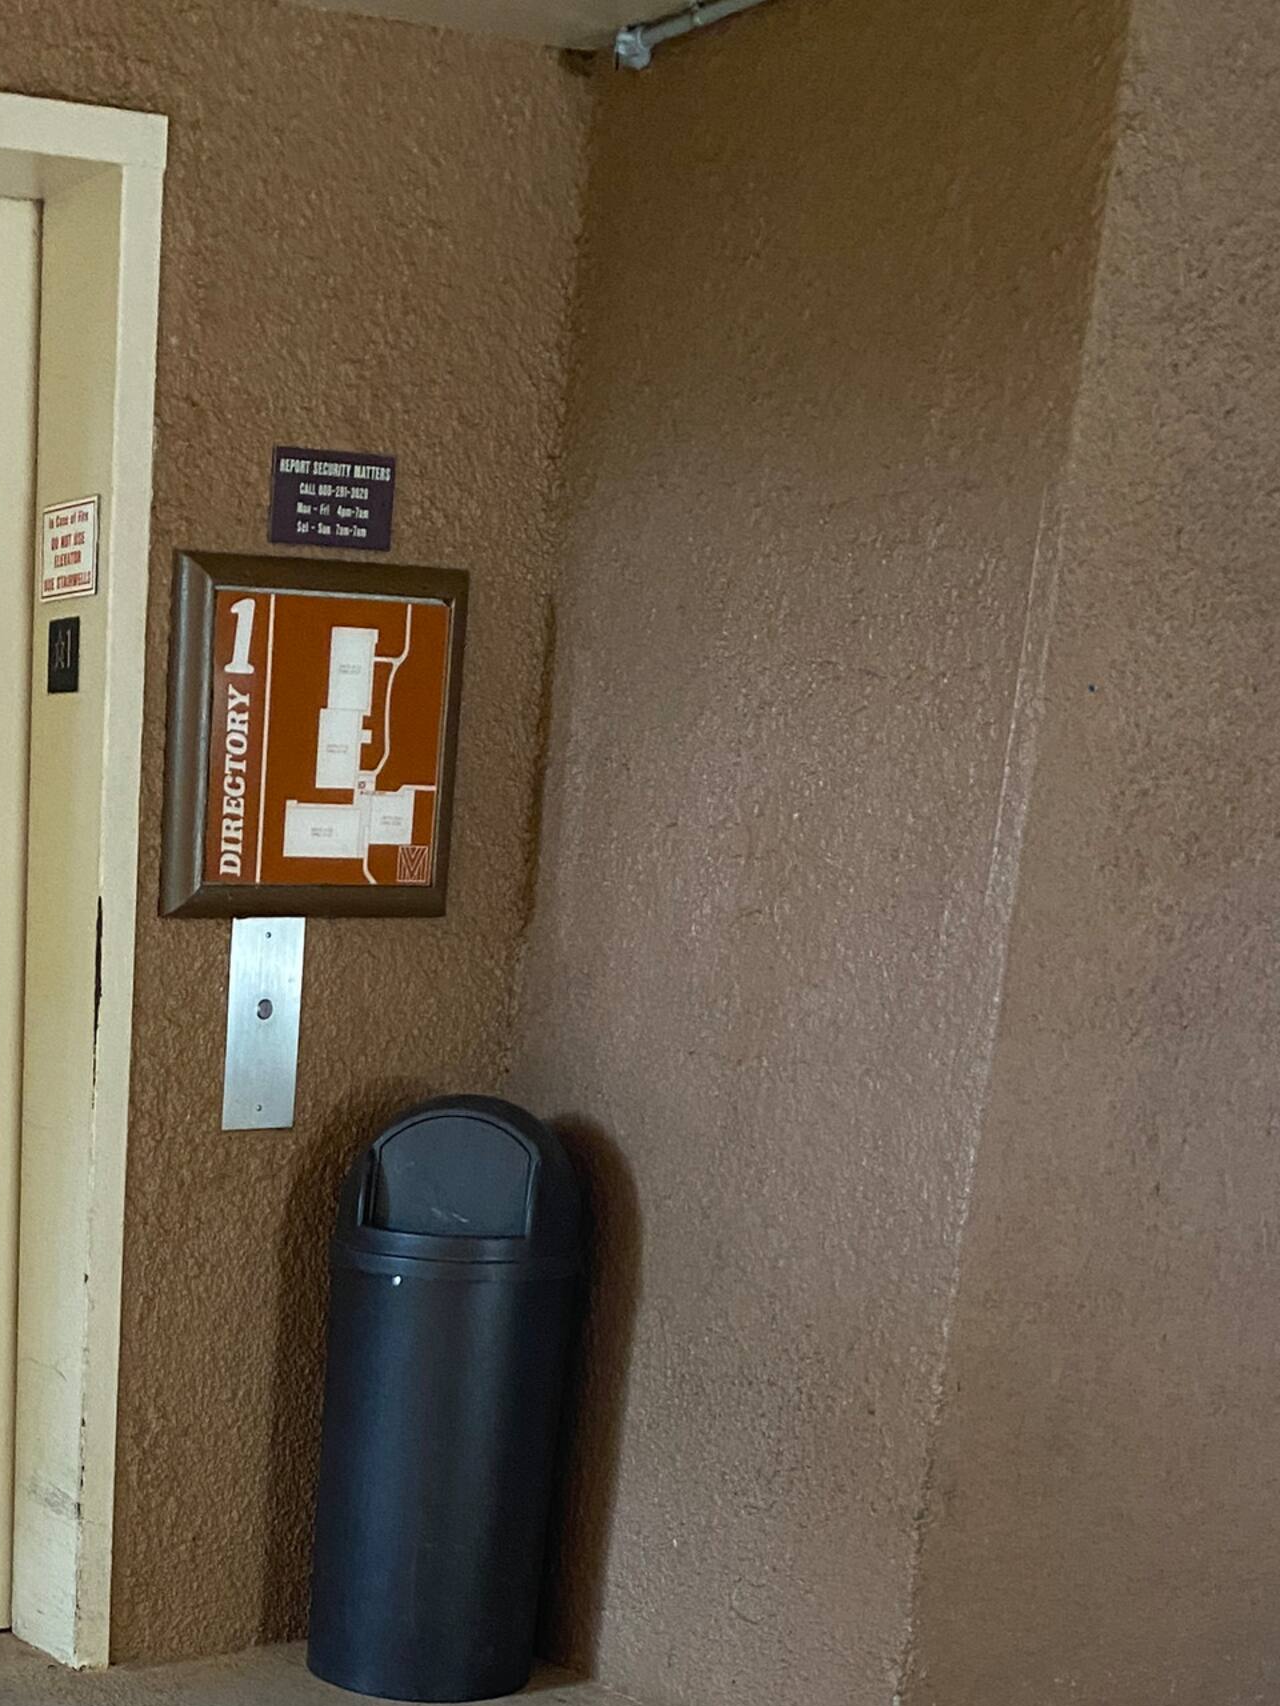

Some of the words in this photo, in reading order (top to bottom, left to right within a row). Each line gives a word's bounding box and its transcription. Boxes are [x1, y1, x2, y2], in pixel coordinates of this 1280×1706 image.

[280, 458, 311, 474] REPORT
[313, 461, 351, 478] SECURITY
[353, 464, 391, 481] MATTERS
[299, 482, 316, 495] CALL
[297, 502, 312, 515] Mon
[320, 503, 330, 516] Fri
[318, 522, 331, 535] Sun
[51, 537, 59, 551] DO
[61, 534, 71, 548] NOT
[74, 531, 85, 545] USE
[54, 550, 81, 568] ELEVATOR
[224, 598, 256, 675] 1
[219, 683, 251, 877] DIRECTORY
